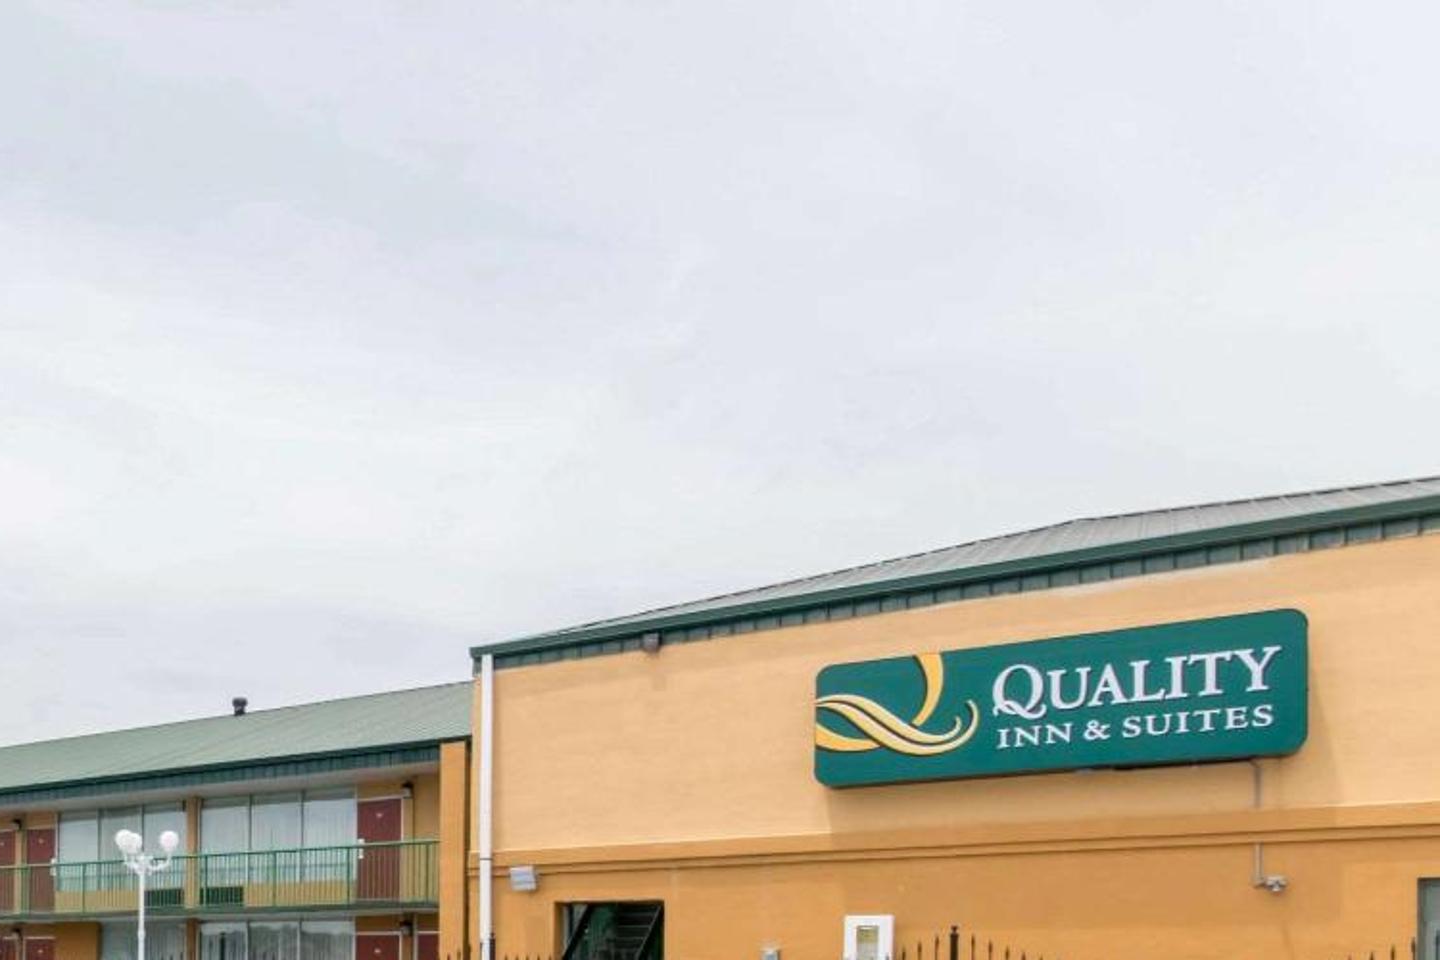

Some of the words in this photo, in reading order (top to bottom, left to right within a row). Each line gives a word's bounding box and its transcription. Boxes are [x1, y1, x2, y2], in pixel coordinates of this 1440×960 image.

[992, 645, 1281, 719] QUALITY
[997, 722, 1073, 749] INN
[1083, 719, 1111, 741] &
[1122, 704, 1274, 738] SUITES
